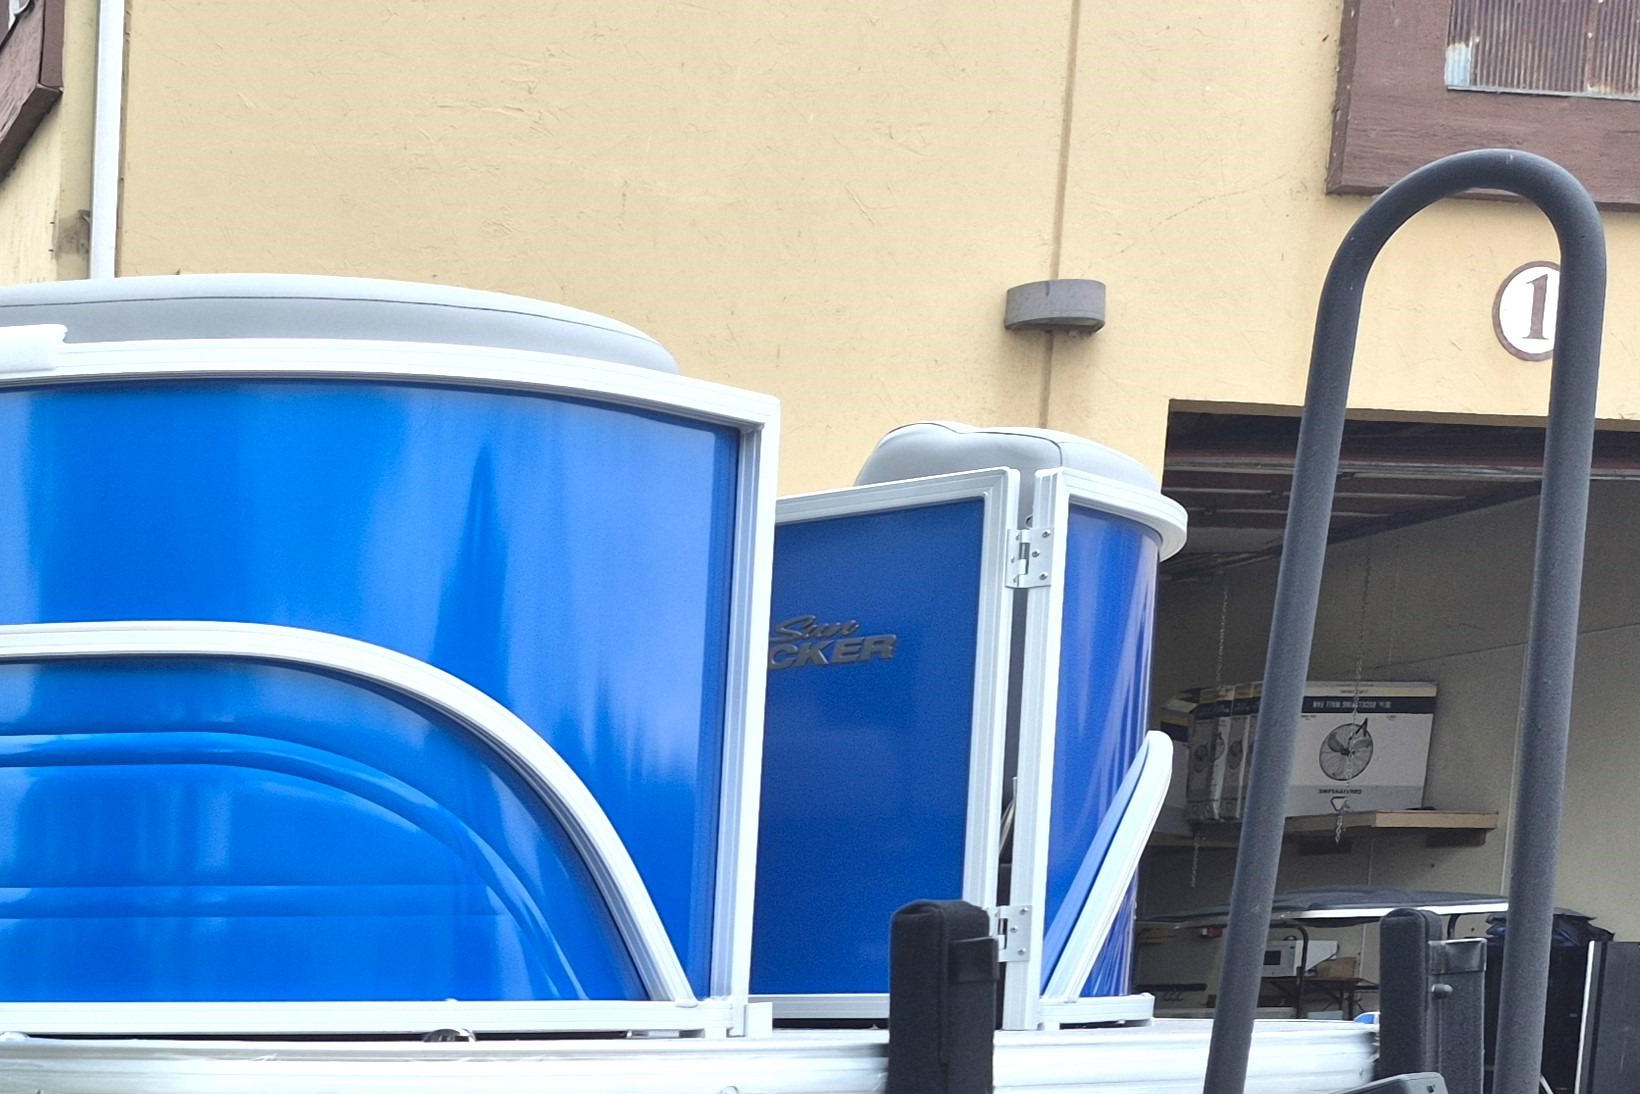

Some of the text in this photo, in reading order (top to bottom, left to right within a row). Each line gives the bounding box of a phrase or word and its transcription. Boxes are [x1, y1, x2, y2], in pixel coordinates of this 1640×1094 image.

[1522, 273, 1549, 340] 1
[770, 614, 860, 643] Sun
[768, 633, 898, 671] CKER
